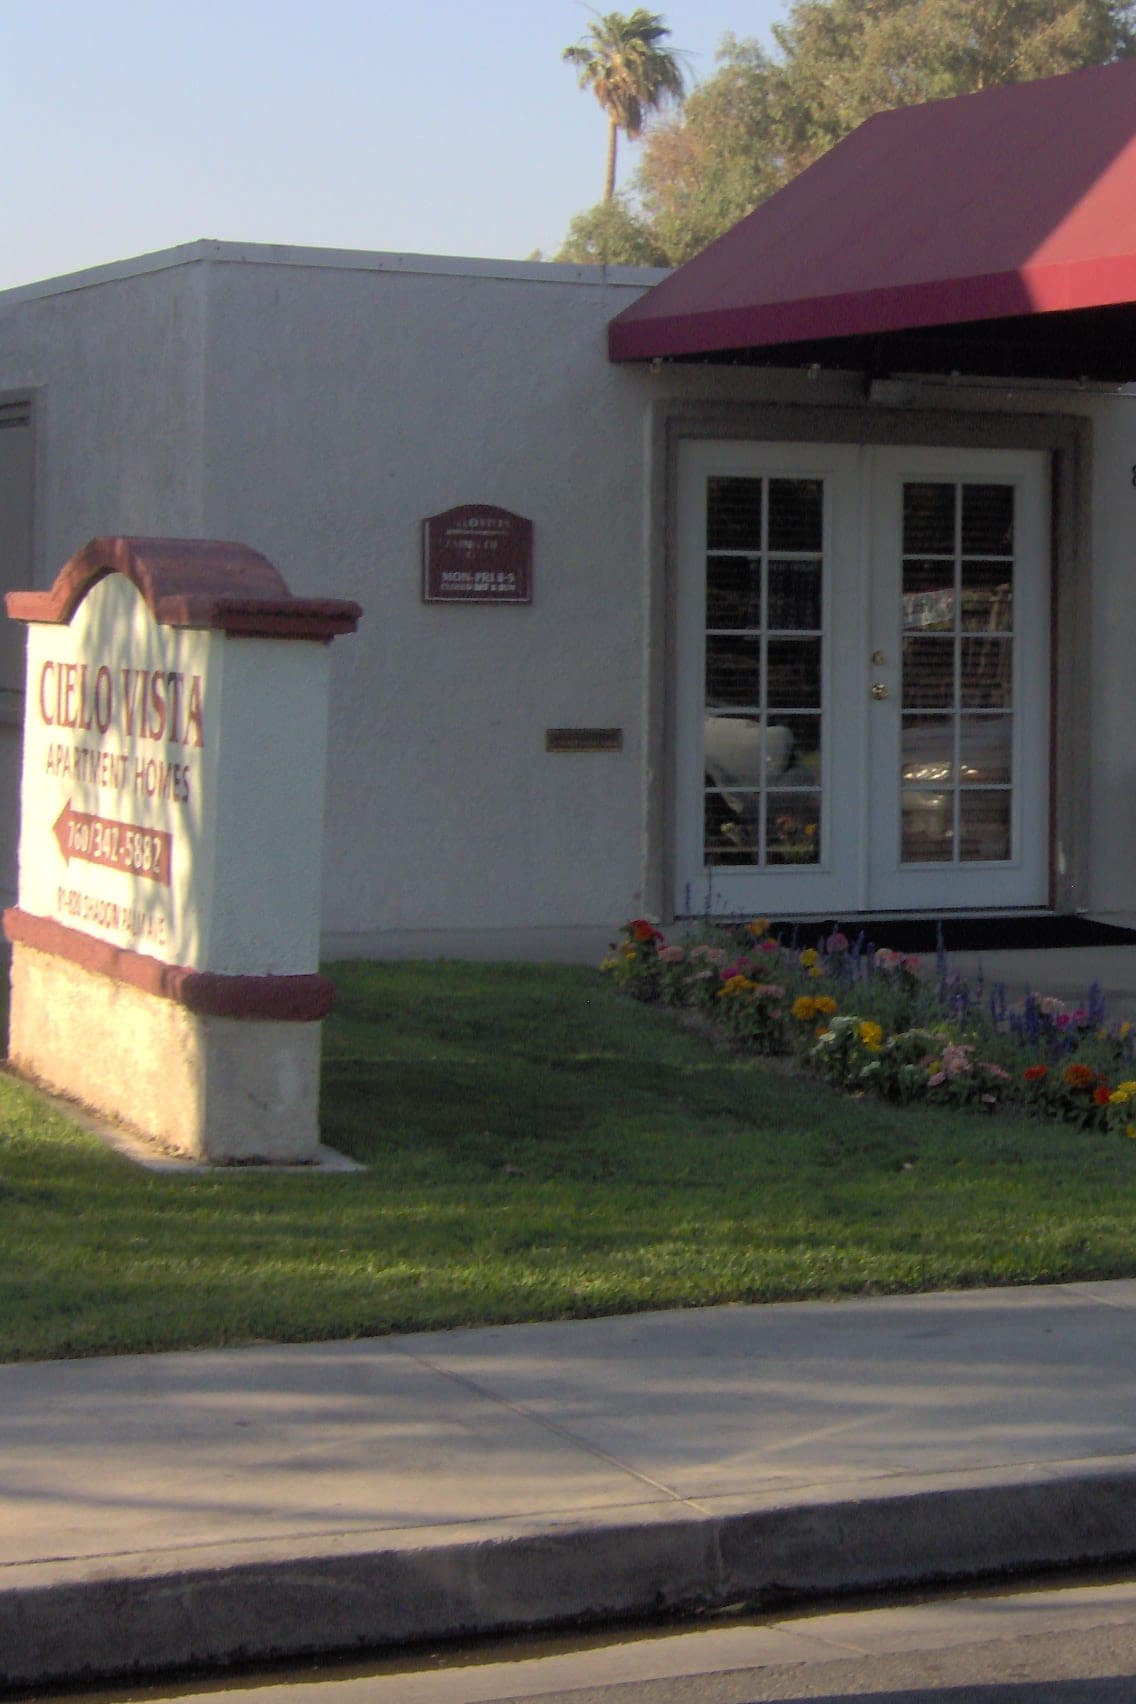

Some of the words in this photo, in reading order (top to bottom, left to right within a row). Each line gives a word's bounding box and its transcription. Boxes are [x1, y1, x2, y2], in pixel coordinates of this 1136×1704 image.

[40, 660, 112, 734] CIELO
[122, 669, 204, 747] VISTA
[46, 744, 128, 790] APARTMENT
[135, 758, 190, 803] HOMES
